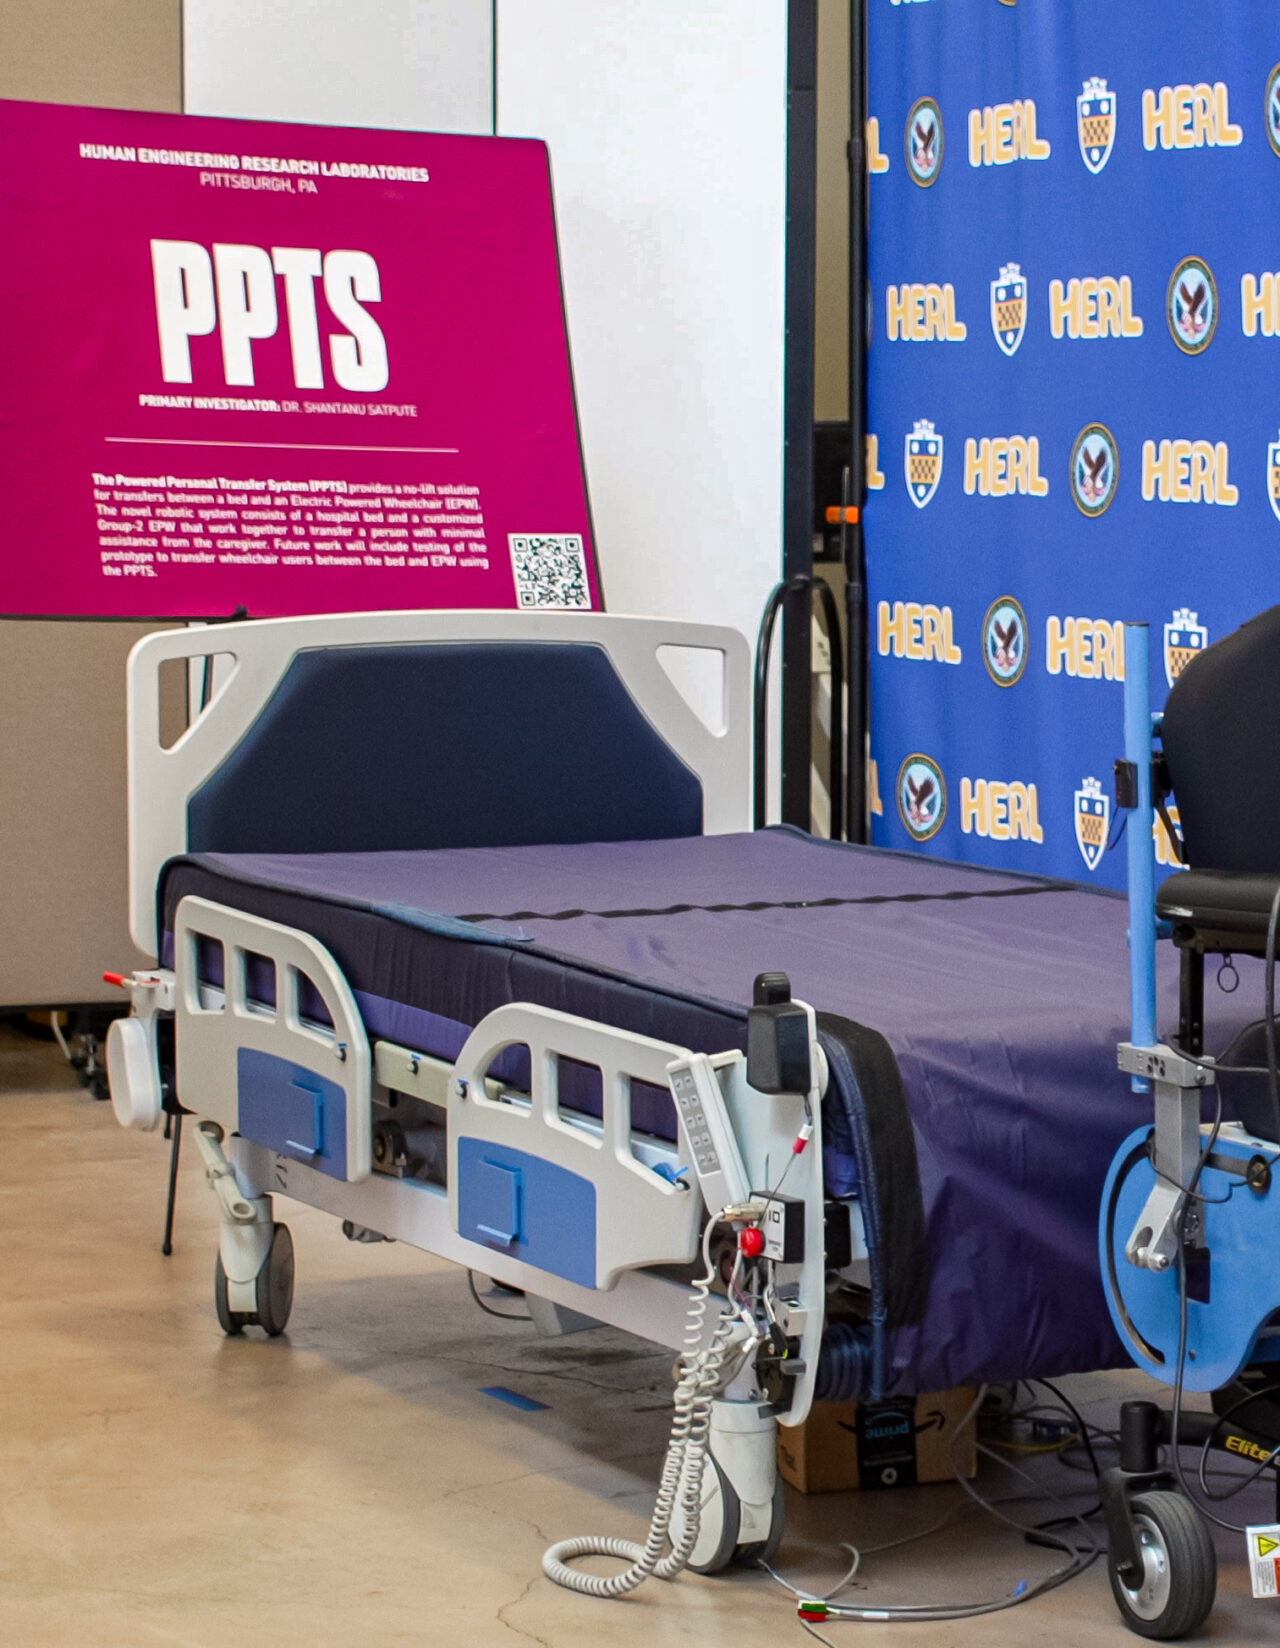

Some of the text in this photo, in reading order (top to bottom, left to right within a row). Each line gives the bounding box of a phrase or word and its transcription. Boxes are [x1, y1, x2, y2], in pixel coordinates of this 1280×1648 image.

[1142, 82, 1242, 150] HERL
[969, 99, 1050, 166] HERL
[80, 144, 429, 182] HUMAN ENGINEERING RESEARCH LABORATORIES
[200, 172, 317, 193] PITTSBURGH, PA
[150, 239, 389, 392] PPTS
[887, 284, 966, 341] HERL
[1049, 276, 1143, 338] HERL
[139, 394, 417, 416] PRIMARY INVESTIGATOR: DR. SHANTANU SATPUTE
[964, 436, 1048, 496] HERL
[1142, 440, 1238, 505] HERL
[92, 473, 114, 486] The
[115, 474, 165, 487] Powered
[167, 476, 218, 489] Personal
[218, 477, 266, 490] Transfer
[267, 479, 308, 493] System
[349, 483, 393, 494] provides
[395, 485, 401, 494] a
[438, 485, 479, 495] solution
[94, 489, 110, 500] for
[113, 491, 165, 502] transfers
[167, 492, 214, 503] between
[217, 495, 224, 504] a
[226, 494, 248, 504] bed
[251, 495, 271, 505] and
[274, 497, 288, 505] an
[290, 495, 332, 506] Electric
[335, 496, 381, 508] Powered
[382, 498, 443, 509] Wheelchair
[96, 503, 483, 524] The novel robotic system consists of a hospital bed and a customized
[149, 520, 175, 532] EPW
[180, 522, 203, 533] that
[208, 523, 236, 533] work
[242, 525, 288, 537] together
[293, 526, 305, 535] to
[310, 526, 352, 536] transfer
[359, 528, 366, 536] a
[371, 528, 408, 539] person
[413, 528, 436, 537] with
[441, 528, 485, 538] minimal
[99, 537, 158, 546] assistance
[162, 536, 189, 547] from
[193, 538, 212, 548] the
[274, 538, 310, 550] Future
[314, 541, 342, 550] work
[346, 541, 365, 551] will
[369, 542, 408, 552] include
[413, 543, 450, 555] testing
[454, 542, 465, 552] of
[469, 542, 487, 552] the
[101, 551, 489, 569] prototype to transfer wheelchair users between the bed and EPW using
[103, 565, 121, 576] the
[879, 601, 961, 664] HERL
[961, 778, 1043, 843] HERL
[866, 1421, 909, 1438] prime
[1226, 1435, 1271, 1462] Elite
